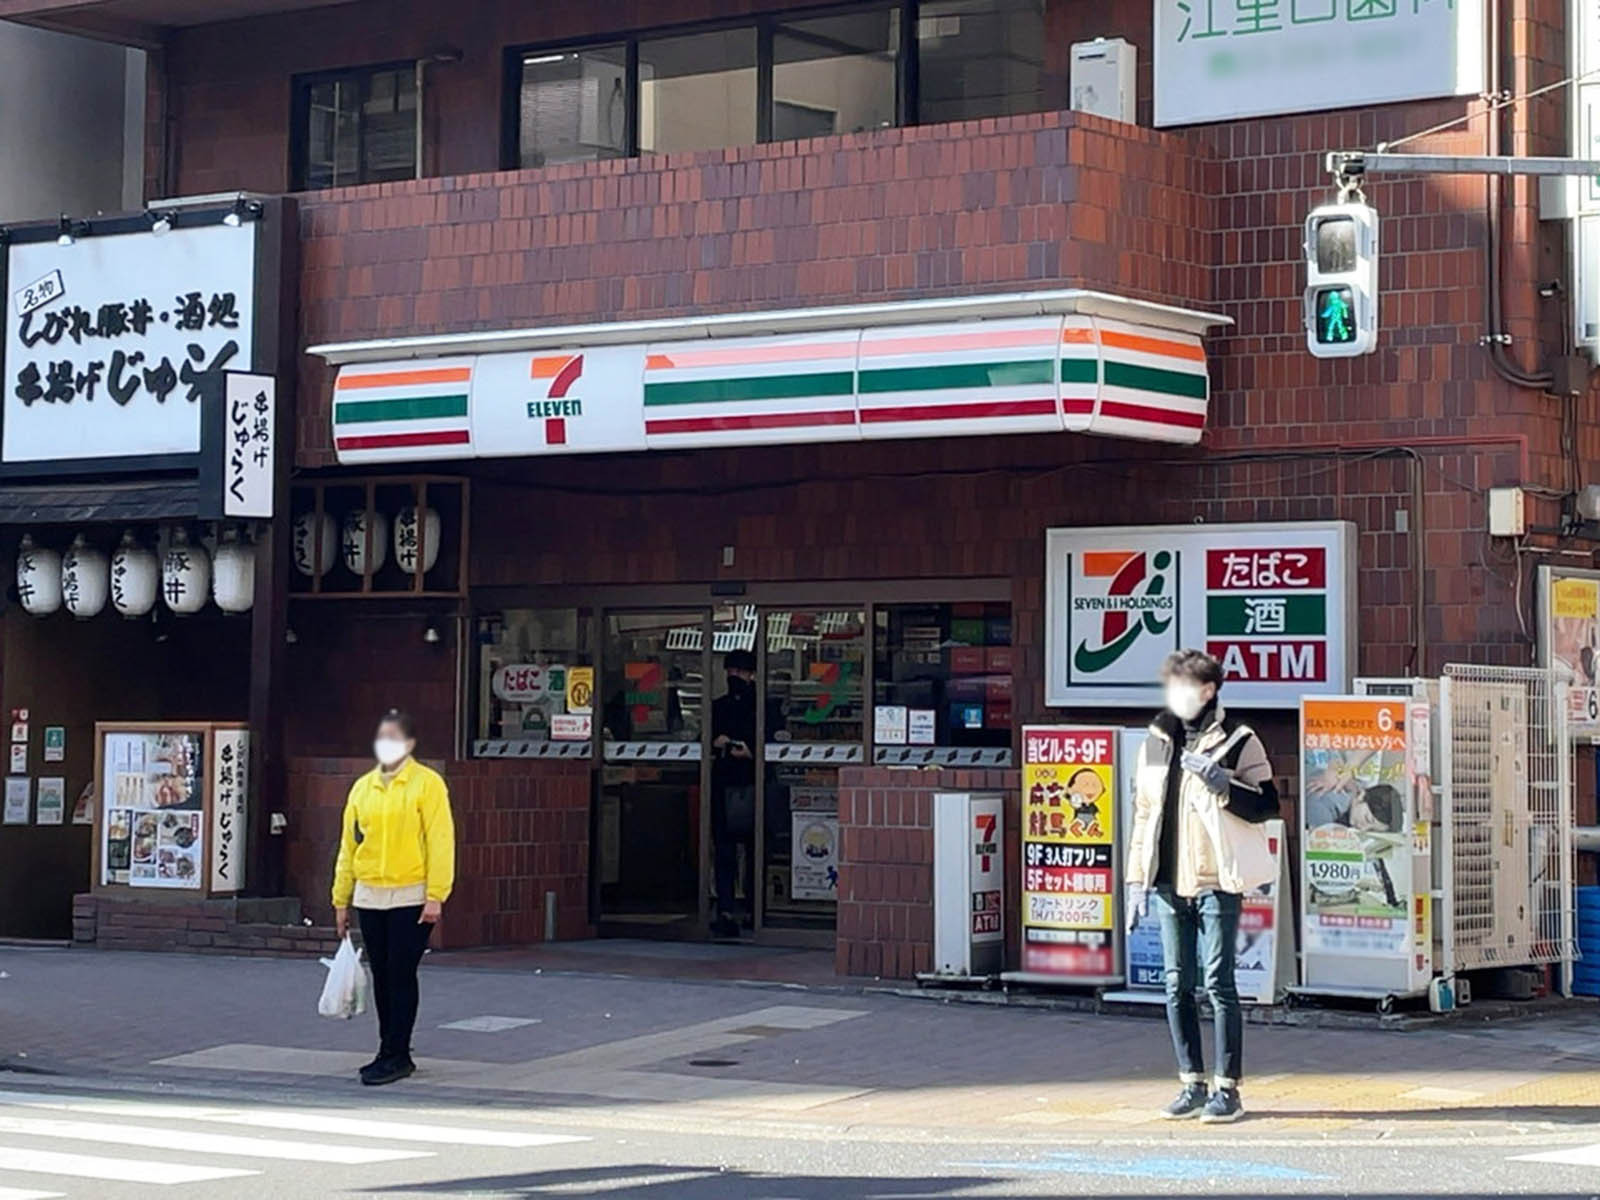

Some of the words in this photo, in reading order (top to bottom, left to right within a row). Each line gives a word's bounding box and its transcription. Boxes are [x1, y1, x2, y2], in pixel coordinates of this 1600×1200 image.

[252, 391, 269, 468] 串揚げ
[230, 400, 250, 502] じゅらく
[1222, 551, 1310, 587] たばこ
[1074, 597, 1105, 610] SEVEN
[1120, 596, 1174, 609] HOLDINGS
[1244, 598, 1287, 634] 酒
[1222, 644, 1316, 679] ATM
